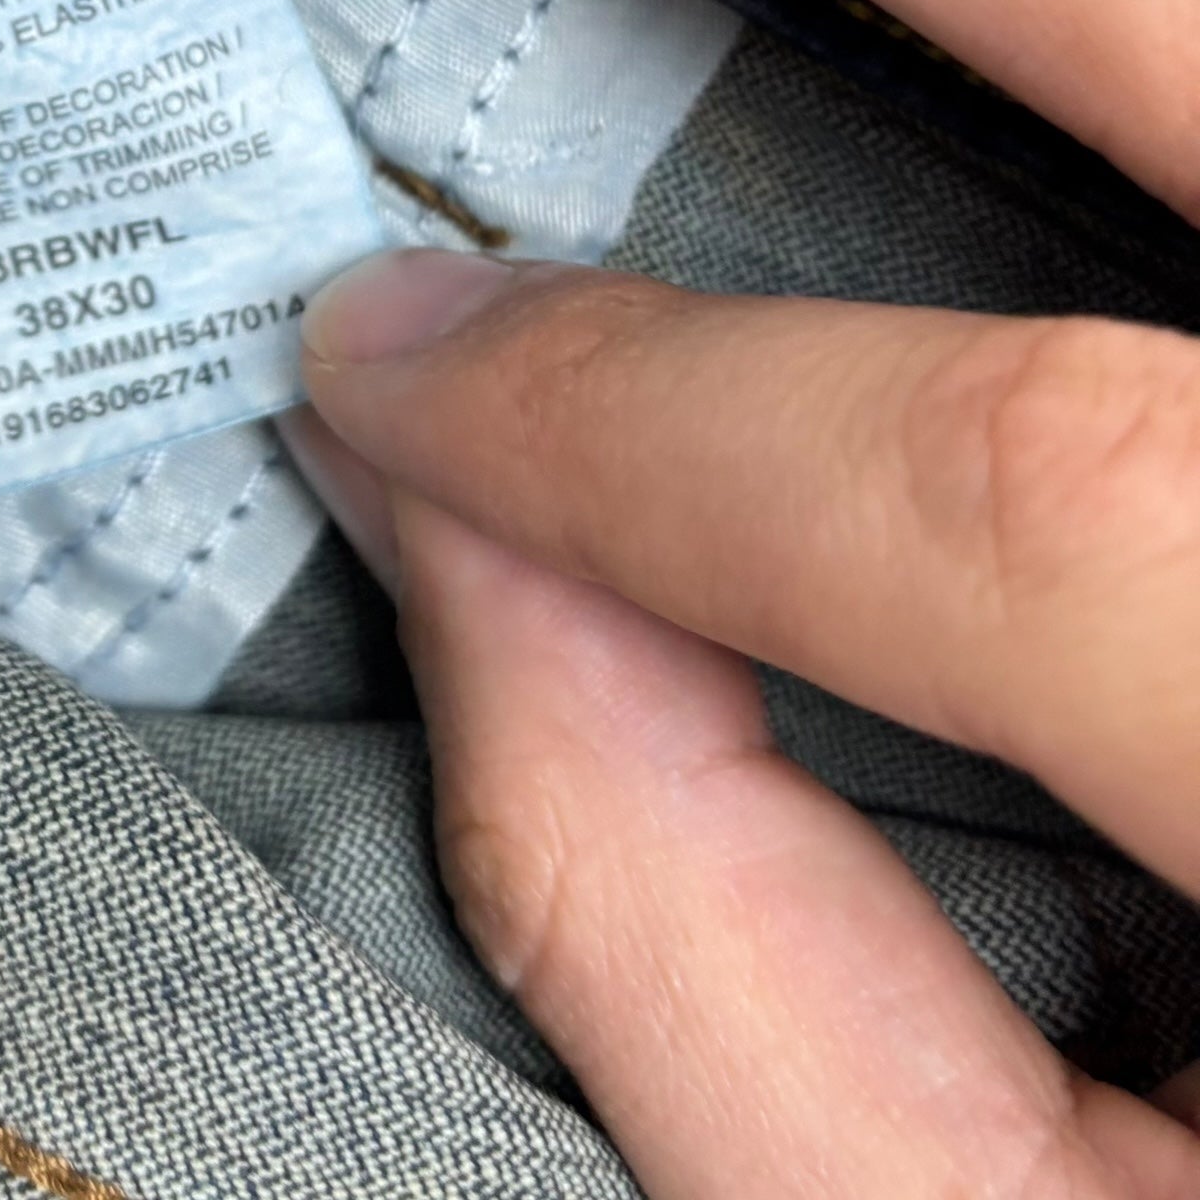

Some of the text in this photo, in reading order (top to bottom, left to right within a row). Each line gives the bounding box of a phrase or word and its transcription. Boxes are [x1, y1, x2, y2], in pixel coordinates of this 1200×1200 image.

[25, 34, 231, 124] DECORATION
[20, 156, 62, 189] OF
[70, 111, 232, 177] TRIMMING
[26, 184, 96, 218] NON
[103, 130, 274, 199] COMPRISE
[14, 275, 157, 338] 38X30
